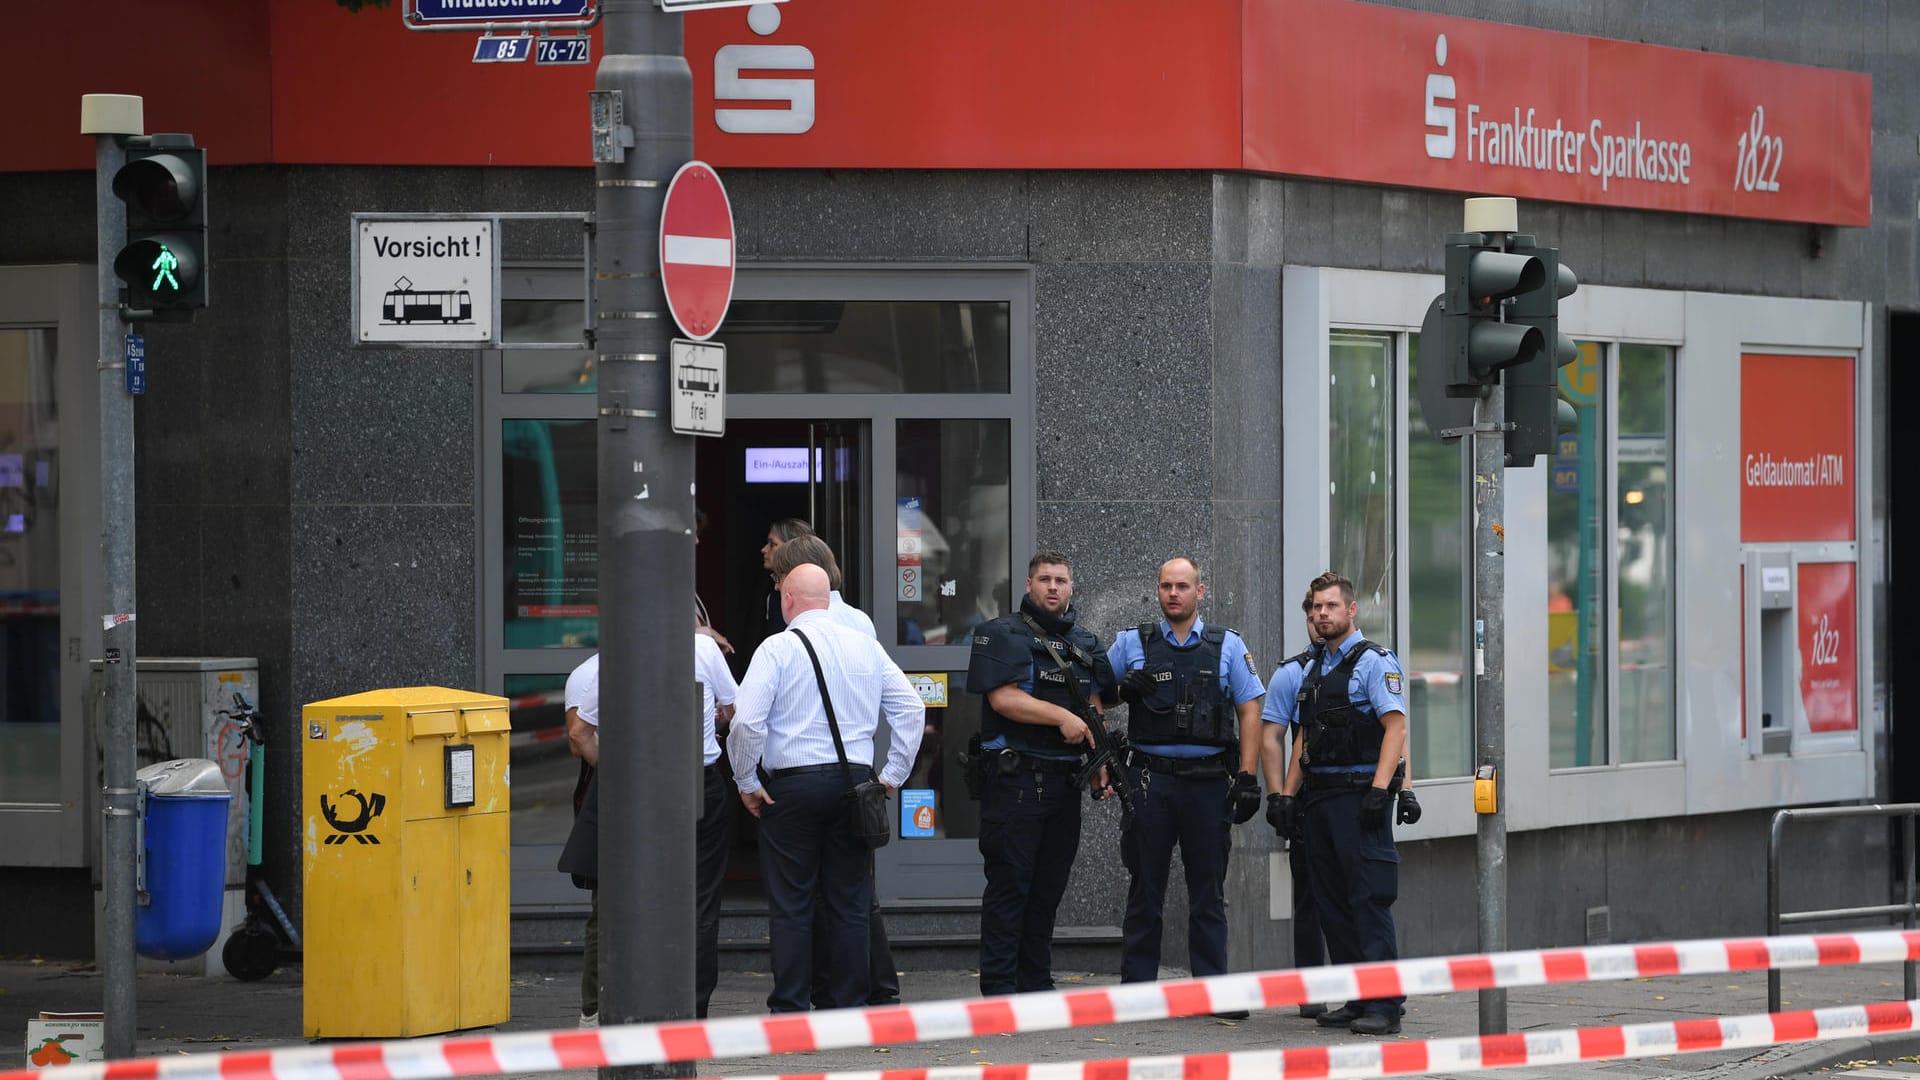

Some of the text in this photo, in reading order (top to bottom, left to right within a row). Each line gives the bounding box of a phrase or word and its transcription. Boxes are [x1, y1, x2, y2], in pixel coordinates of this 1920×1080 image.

[496, 40, 518, 59] 85
[539, 41, 587, 61] 76-72
[1467, 103, 1586, 174] Frankfurter
[1590, 119, 1691, 192] Sparkasse
[1733, 105, 1784, 192] 1822
[690, 401, 707, 420] frei
[1745, 452, 1843, 487] Geldautomat/ATM
[1811, 613, 1840, 666] 1822
